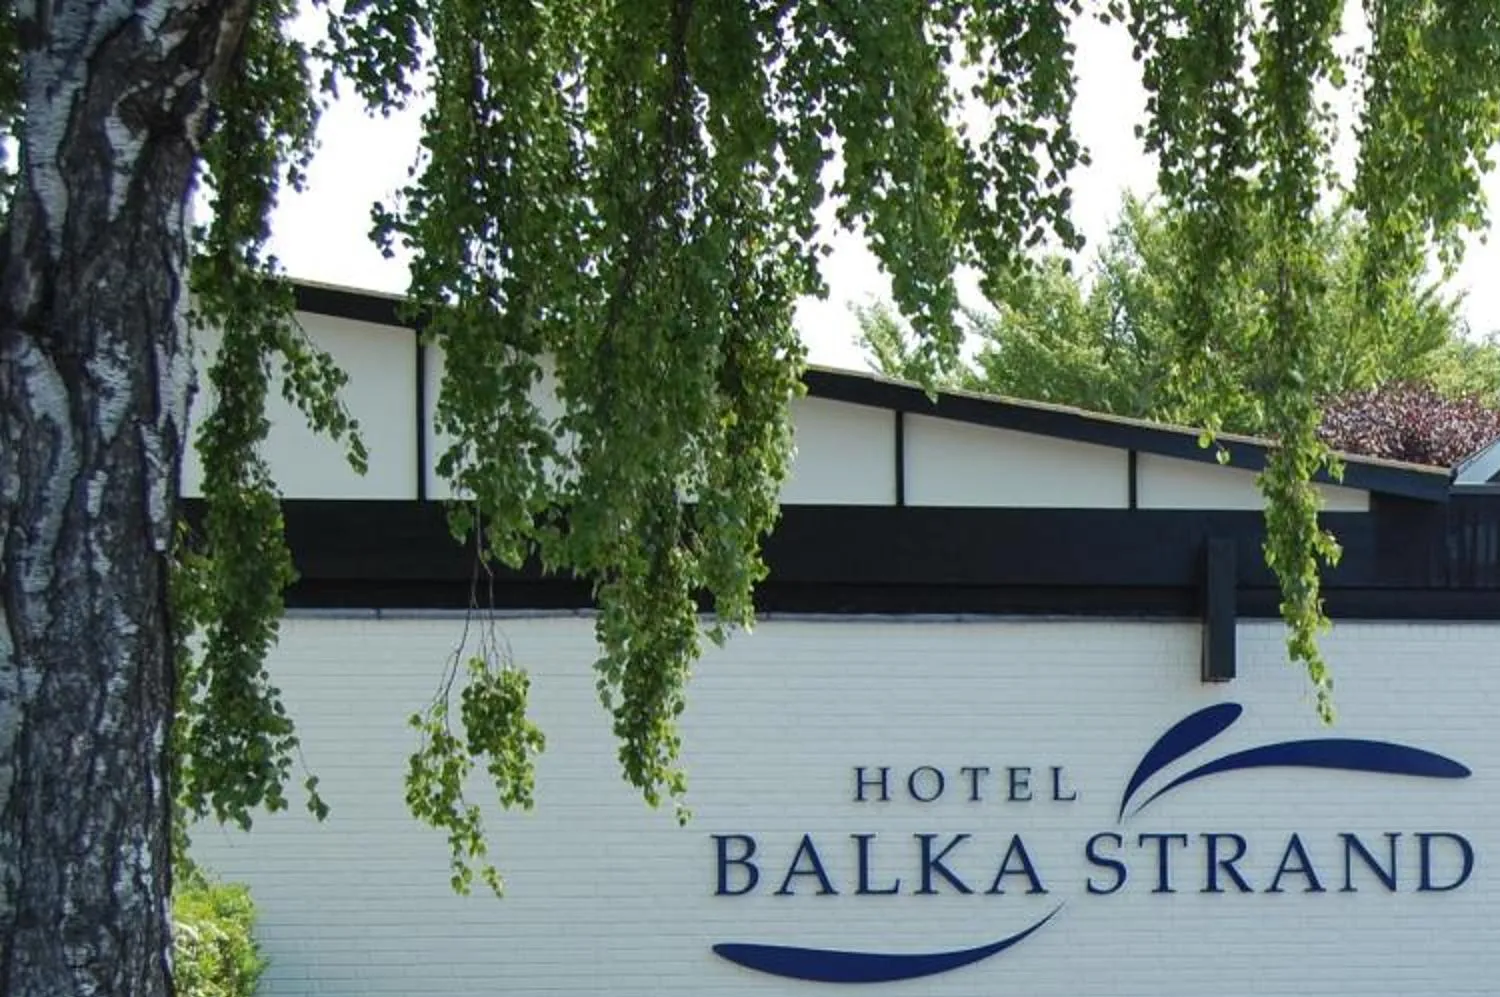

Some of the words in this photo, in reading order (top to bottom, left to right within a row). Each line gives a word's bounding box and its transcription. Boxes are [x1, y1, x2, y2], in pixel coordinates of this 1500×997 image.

[853, 765, 1077, 803] HOTEL
[709, 833, 1049, 897] BALKA
[1084, 831, 1476, 896] STRAND
